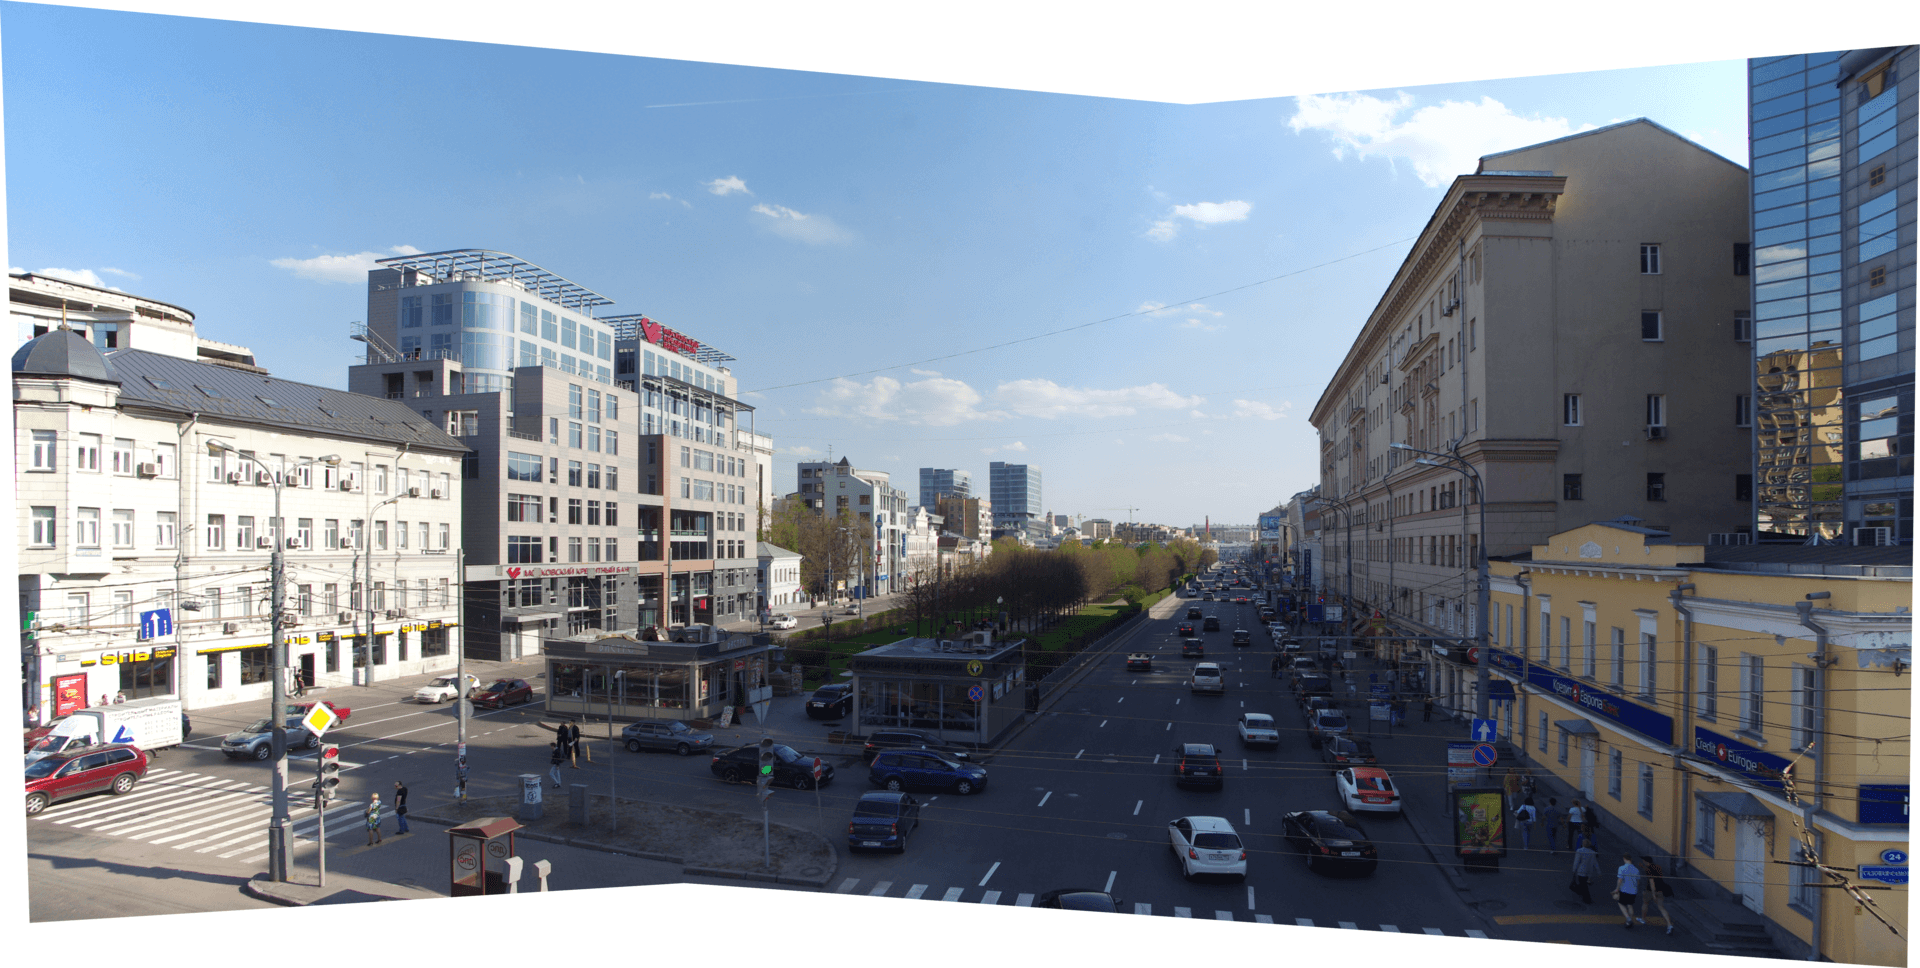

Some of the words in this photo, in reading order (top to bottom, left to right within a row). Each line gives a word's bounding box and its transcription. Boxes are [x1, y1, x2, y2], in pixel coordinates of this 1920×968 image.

[524, 567, 575, 577] МОКОВСКИЙ
[1552, 678, 1572, 696] Кредит
[1580, 689, 1603, 710] Европа
[1695, 737, 1717, 755] Credit
[1728, 750, 1758, 772] Europe
[1888, 853, 1902, 861] 24
